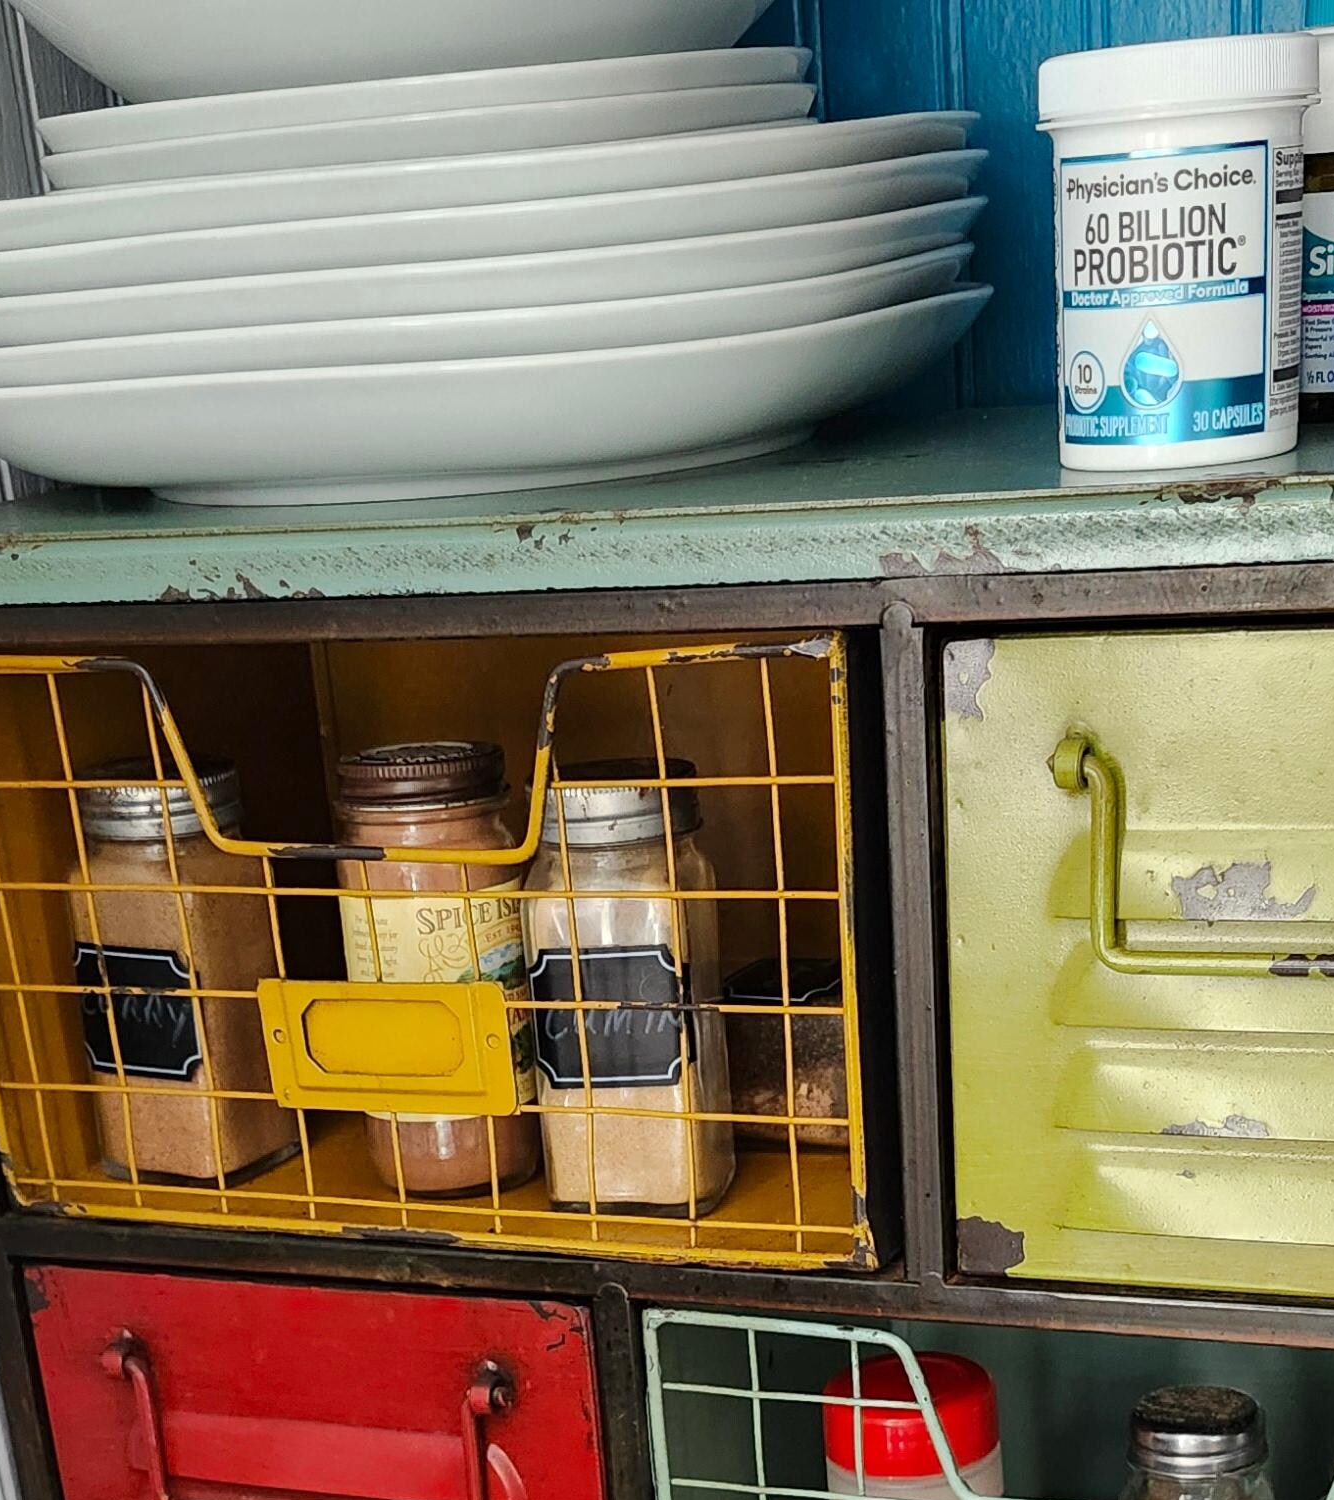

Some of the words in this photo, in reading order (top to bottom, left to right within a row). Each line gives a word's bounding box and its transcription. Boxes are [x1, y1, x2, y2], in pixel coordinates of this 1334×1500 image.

[1066, 172, 1169, 204] Physician's
[1085, 213, 1110, 245] 60
[1118, 202, 1227, 243] BILLION
[1071, 291, 1110, 307] Doctor
[1110, 286, 1185, 308] Approved
[1187, 279, 1250, 299] Formula
[1077, 363, 1093, 385] 10
[1315, 372, 1325, 383] FL
[1193, 410, 1209, 433] 30
[1212, 402, 1264, 431] CAPSULES
[416, 902, 493, 935] SPICE
